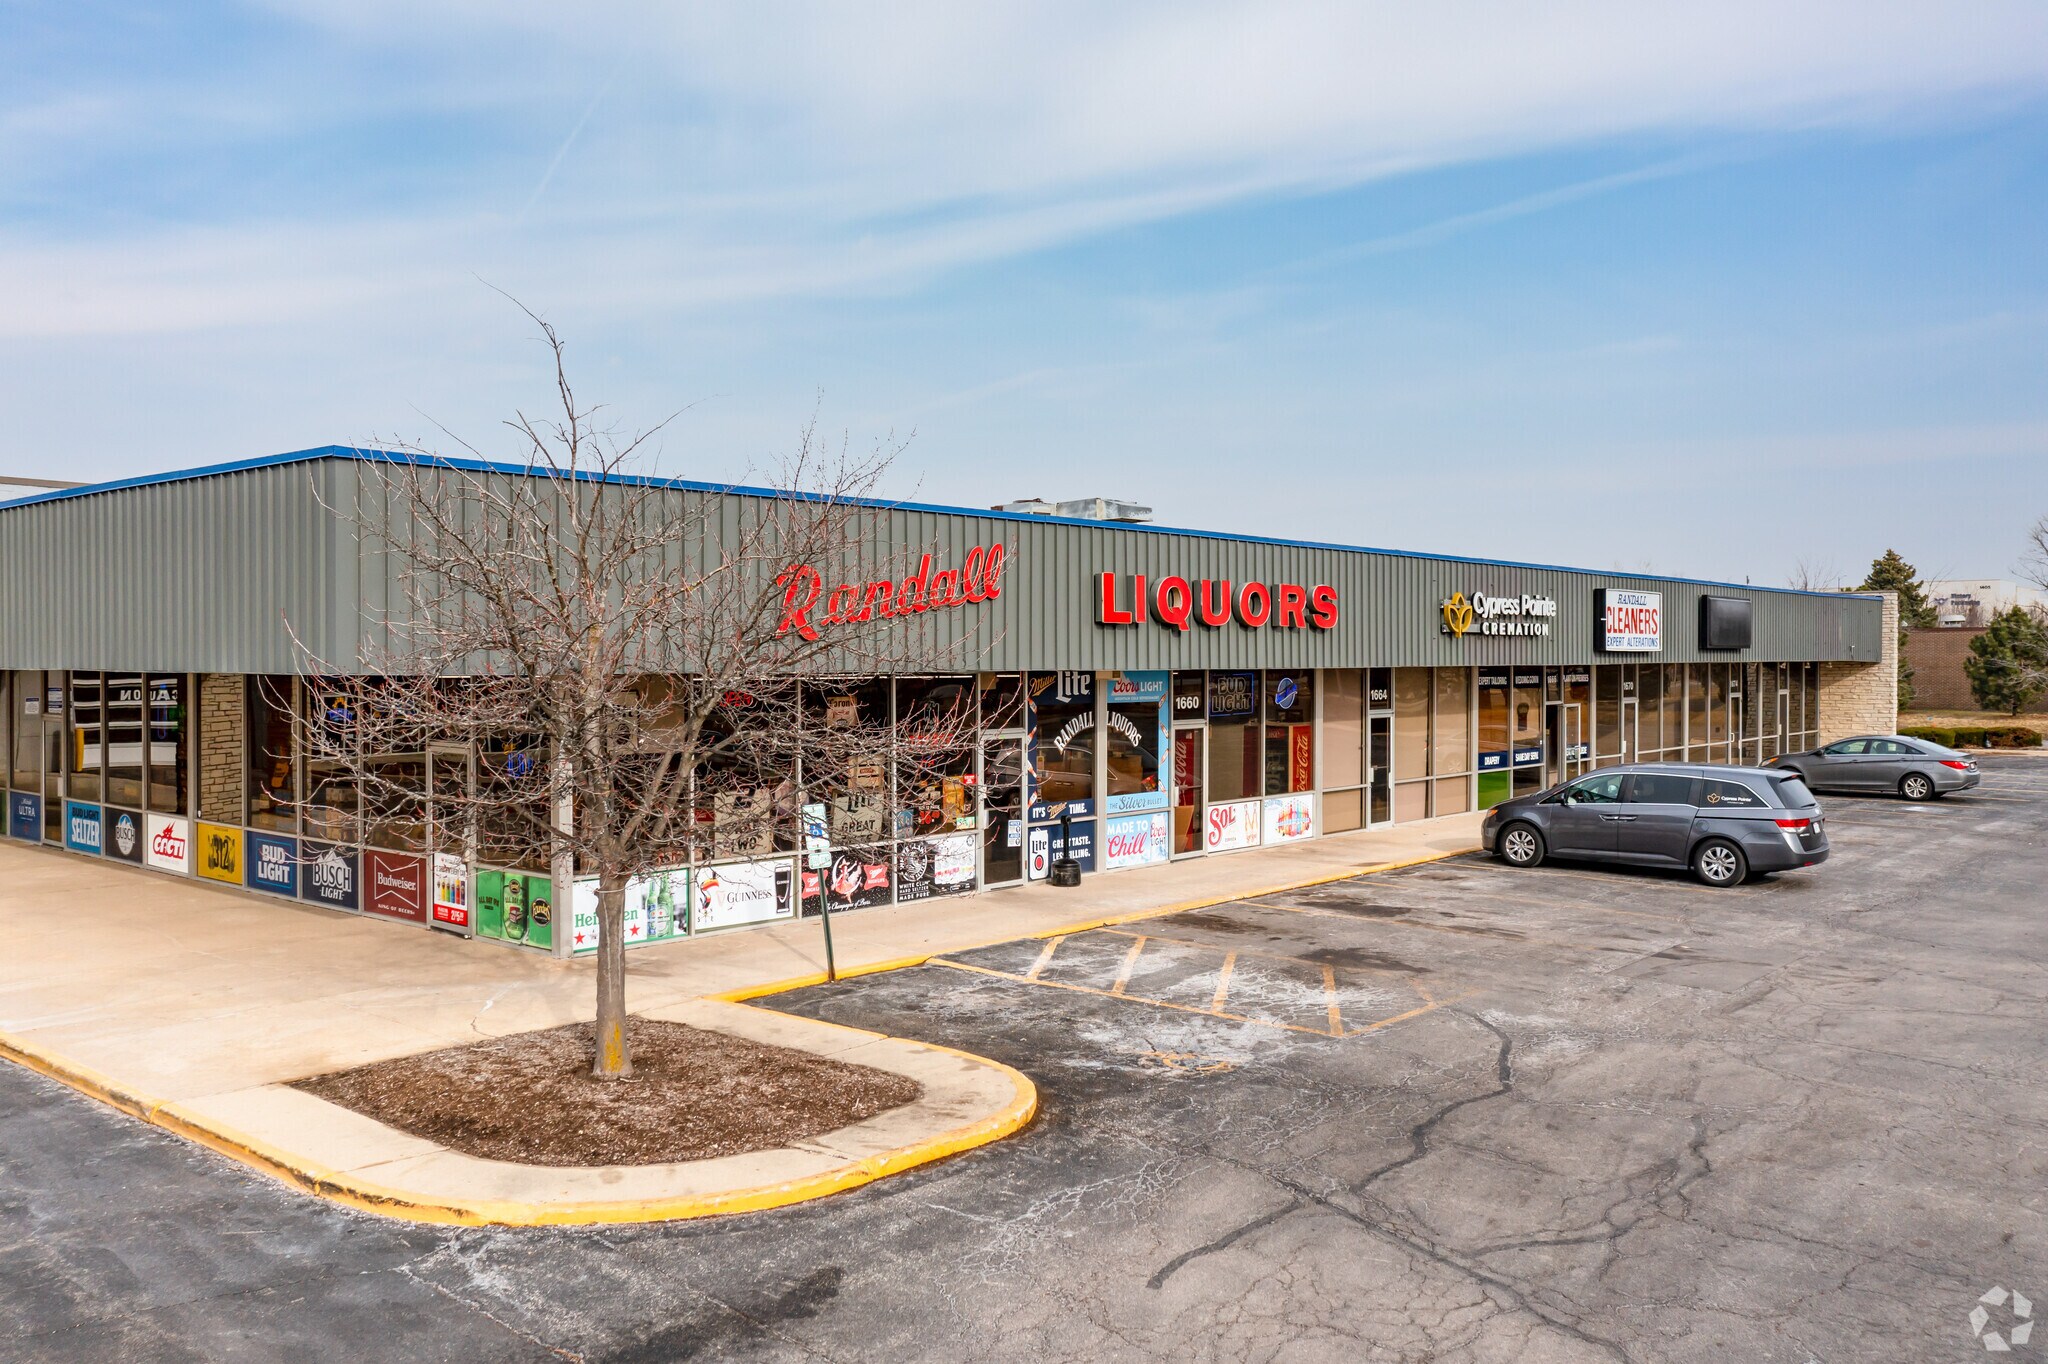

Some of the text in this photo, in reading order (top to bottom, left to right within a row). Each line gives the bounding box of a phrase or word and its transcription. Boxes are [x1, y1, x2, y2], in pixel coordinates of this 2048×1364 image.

[775, 543, 1002, 641] Randall
[1618, 594, 1647, 605] RANDALL
[1094, 572, 1338, 632] LIQUORS
[1473, 592, 1557, 618] Cypress Pointe
[1482, 622, 1548, 636] CREMATION
[1607, 606, 1658, 635] CLEANERS
[1607, 637, 1658, 647] EXPERT ALTERATIONS
[1030, 671, 1091, 703] Miller Lite
[1113, 679, 1163, 693] Coors LIGHT
[1218, 677, 1246, 694] BUD
[1176, 696, 1199, 709] 1660
[1212, 693, 1252, 713] LIGHT
[1371, 689, 1388, 700] 1664
[1054, 711, 1142, 752] RANDALL LIQUORS
[18, 805, 36, 816] ULTRA
[1033, 802, 1087, 819] IT'S Miller TIME.
[1119, 796, 1146, 810] Silver
[72, 807, 99, 820] BUD LIGHT
[71, 817, 100, 847] SELTZER
[116, 826, 135, 843] BUSCH
[1107, 819, 1149, 835] MADE TO
[1208, 805, 1236, 847] SOL
[153, 834, 185, 860] CACTI
[1031, 839, 1048, 854] Lite
[1072, 835, 1091, 846] TASTE.
[1108, 832, 1148, 858] Chill
[262, 844, 286, 864] BUD
[258, 861, 290, 884] LIGHT
[313, 860, 352, 892] BUSCH
[377, 872, 417, 891] Budweiser
[321, 886, 344, 900] LIGHT
[726, 888, 773, 903] GUINNESS
[574, 908, 639, 928] Heien
